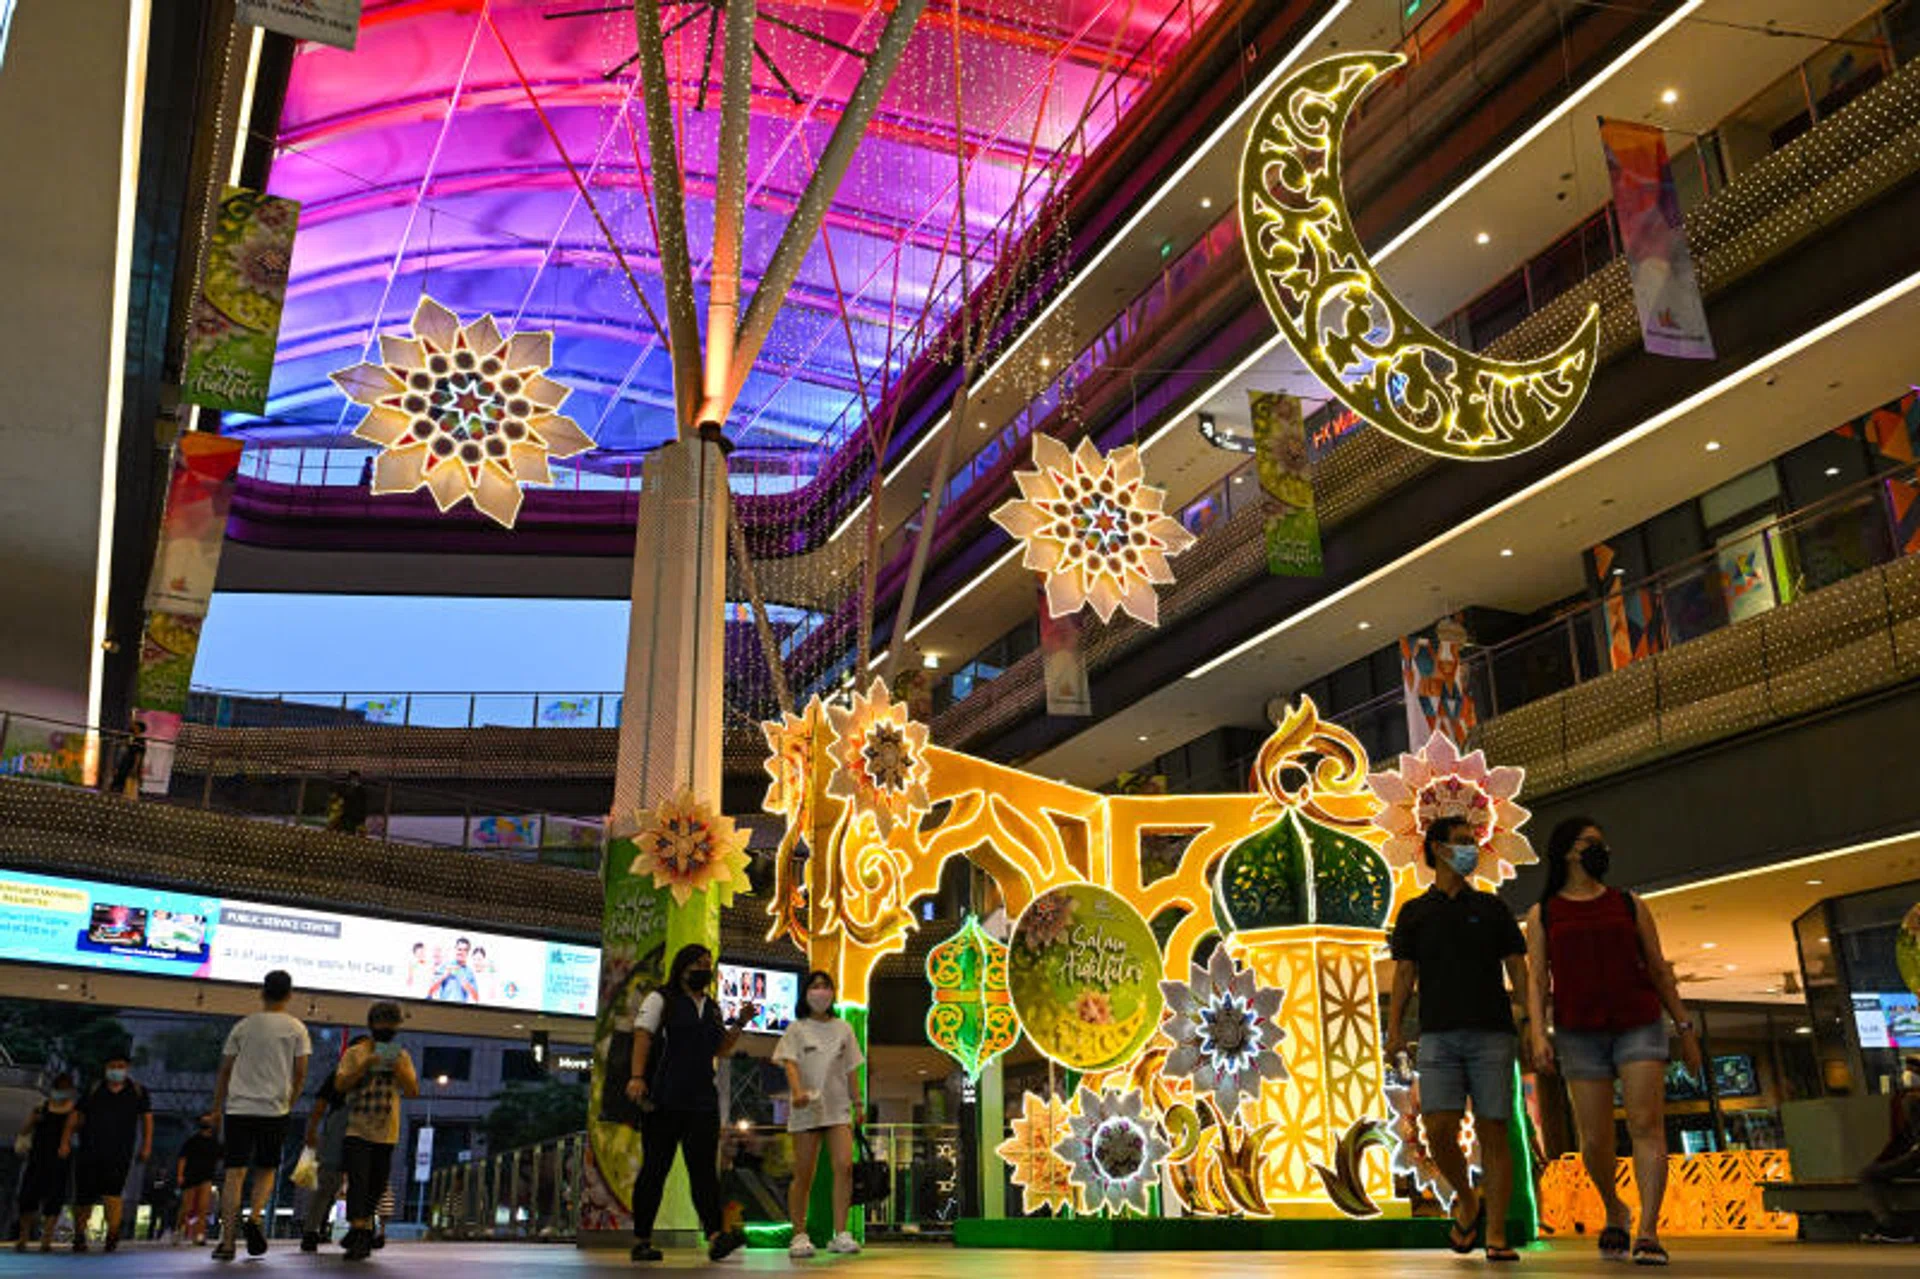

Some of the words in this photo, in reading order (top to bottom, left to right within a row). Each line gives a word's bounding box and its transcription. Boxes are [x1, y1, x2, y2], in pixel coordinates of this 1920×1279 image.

[227, 911, 262, 926] PUBLIC
[263, 916, 299, 930] SERVICE
[300, 922, 337, 935] CENTRE
[1072, 924, 1127, 957] Salam
[1057, 951, 1144, 991] Aidilfitri
[558, 1056, 588, 1070] More
